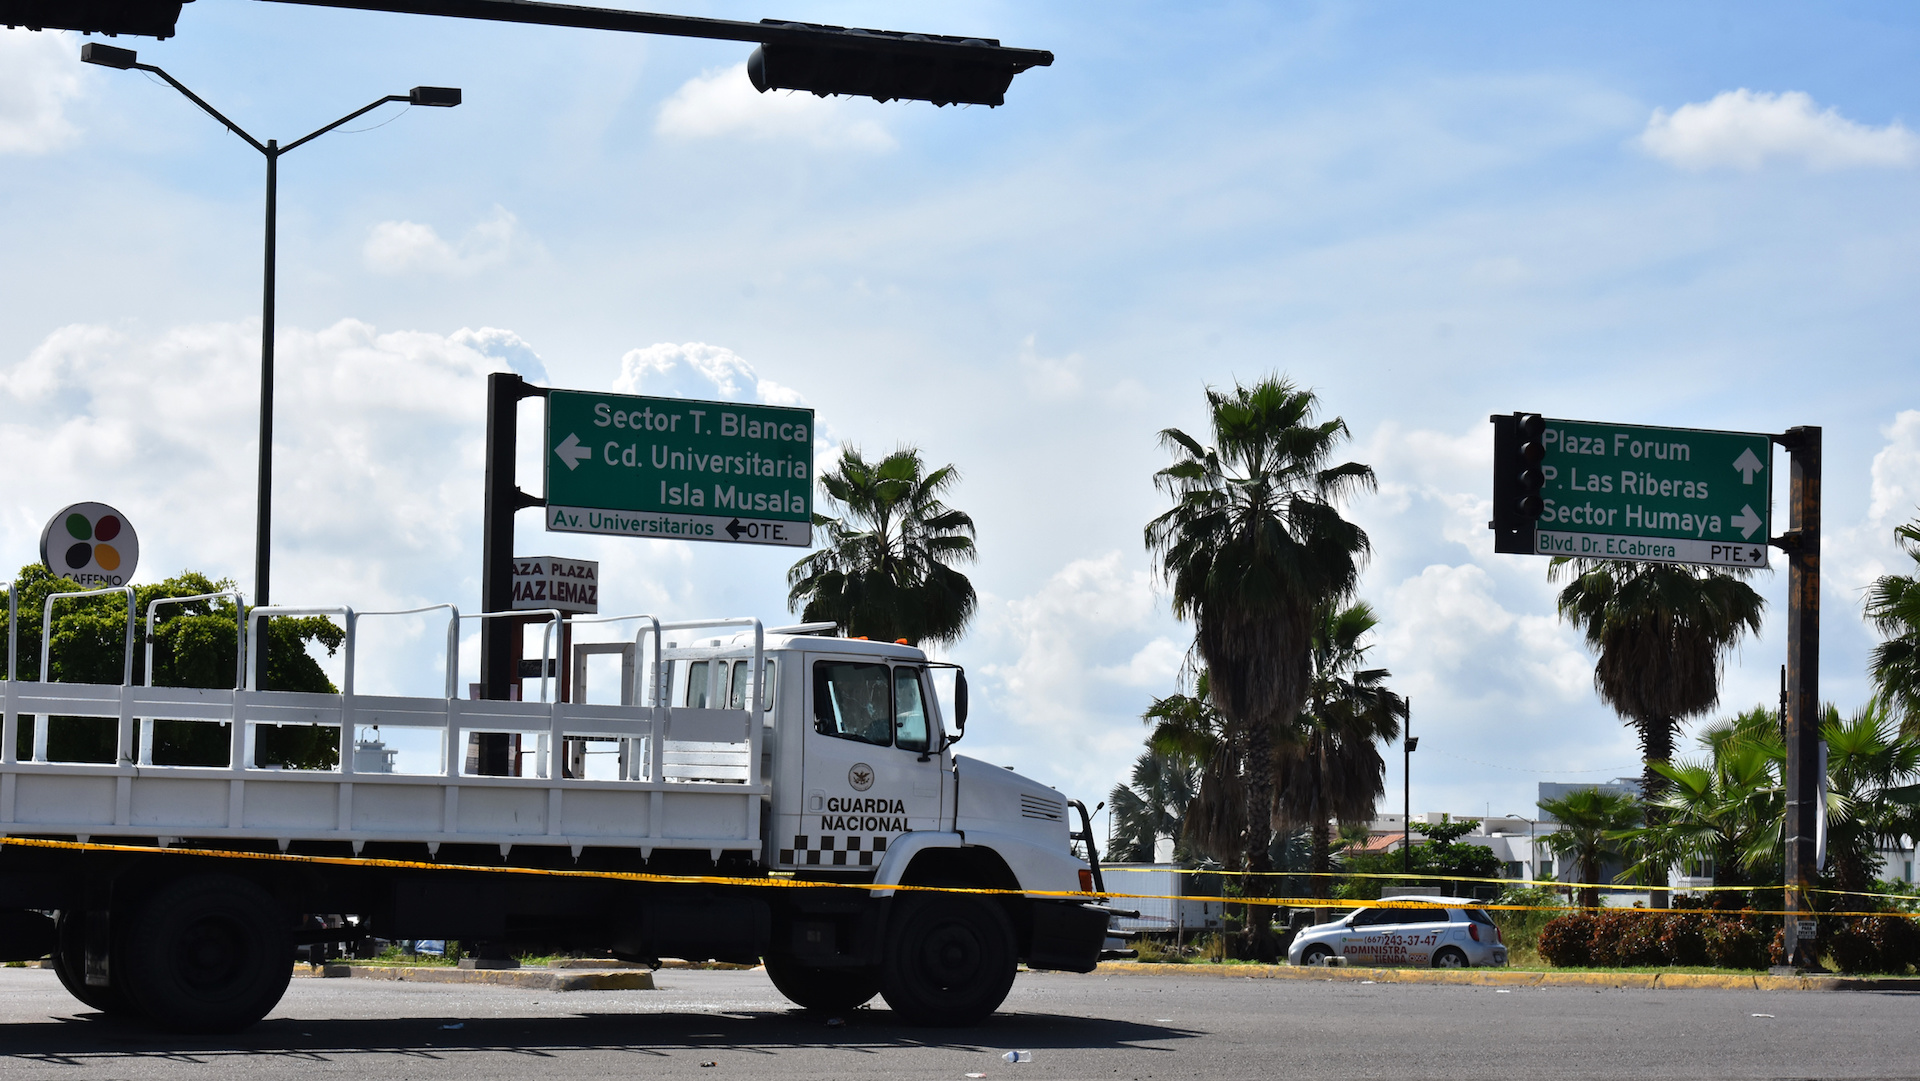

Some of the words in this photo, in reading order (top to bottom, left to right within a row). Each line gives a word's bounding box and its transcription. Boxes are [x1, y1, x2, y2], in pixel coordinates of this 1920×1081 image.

[593, 403, 681, 432] Sector
[689, 410, 712, 435] T.
[720, 412, 808, 443] Blanca
[1542, 428, 1605, 455] Plaza
[1614, 433, 1690, 461] Forum
[603, 441, 642, 468] Cd.
[651, 444, 807, 479] Universitaria
[1542, 464, 1562, 490] P.
[1571, 467, 1613, 493] Las
[1621, 470, 1709, 500] Riberas
[660, 480, 704, 507] Isla
[714, 484, 805, 514] Musala
[553, 510, 583, 528] Av.
[588, 512, 714, 536] Universitarios
[747, 522, 788, 541] OTE.
[1540, 499, 1617, 526] Sector
[1625, 504, 1722, 537] Humaya
[1540, 535, 1577, 553] Blvd.
[1581, 537, 1601, 553] Dr.
[1711, 545, 1747, 563] PTE.
[513, 563, 544, 576] AZA
[551, 563, 595, 580] PLAZA
[512, 580, 547, 601] MAZ
[549, 580, 597, 605] LEMAZ
[827, 797, 906, 814] GUARDIA
[821, 815, 913, 832] NACIONAL
[1343, 945, 1408, 954] ADMINISTRA
[1375, 955, 1407, 964] TIENDA
